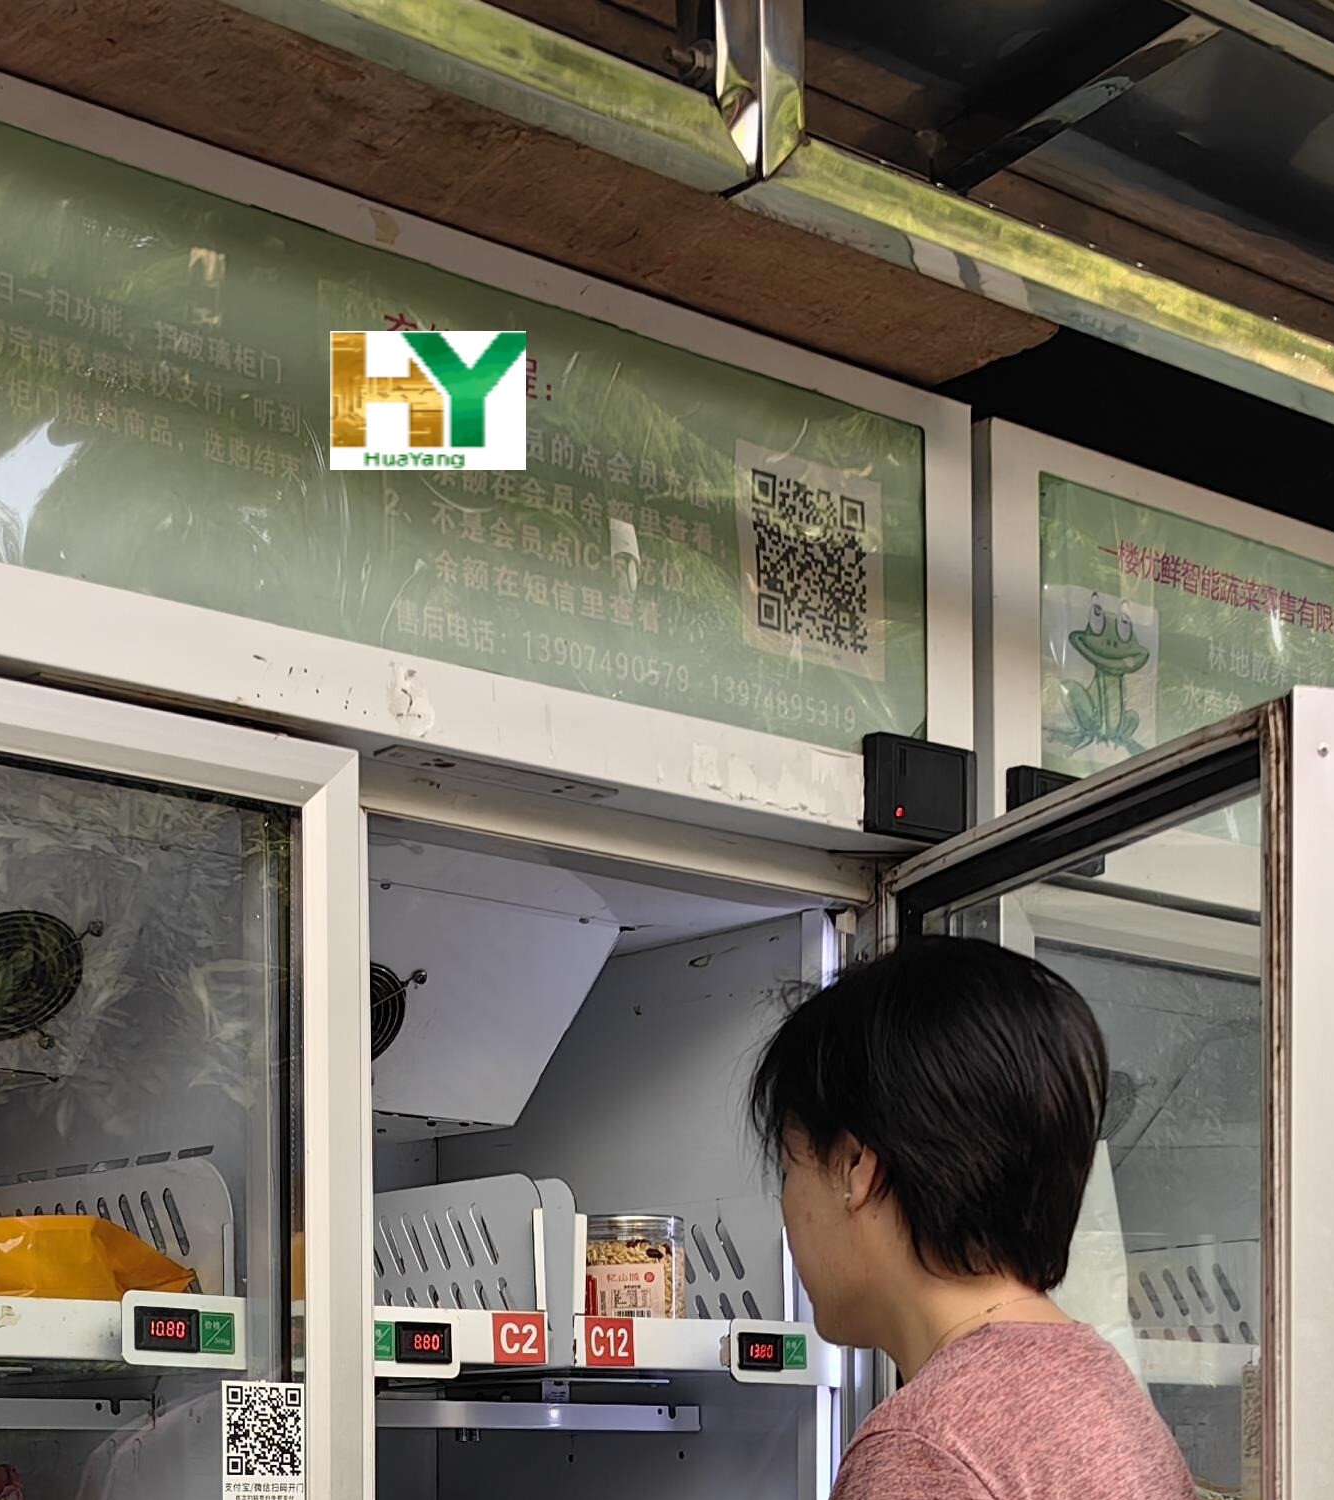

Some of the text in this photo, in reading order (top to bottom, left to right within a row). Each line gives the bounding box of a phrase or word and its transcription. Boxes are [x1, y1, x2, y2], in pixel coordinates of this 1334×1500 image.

[522, 629, 691, 694] 13907490579
[711, 671, 857, 735] 13974895319
[499, 1323, 539, 1355] C2
[589, 1327, 630, 1358] C12
